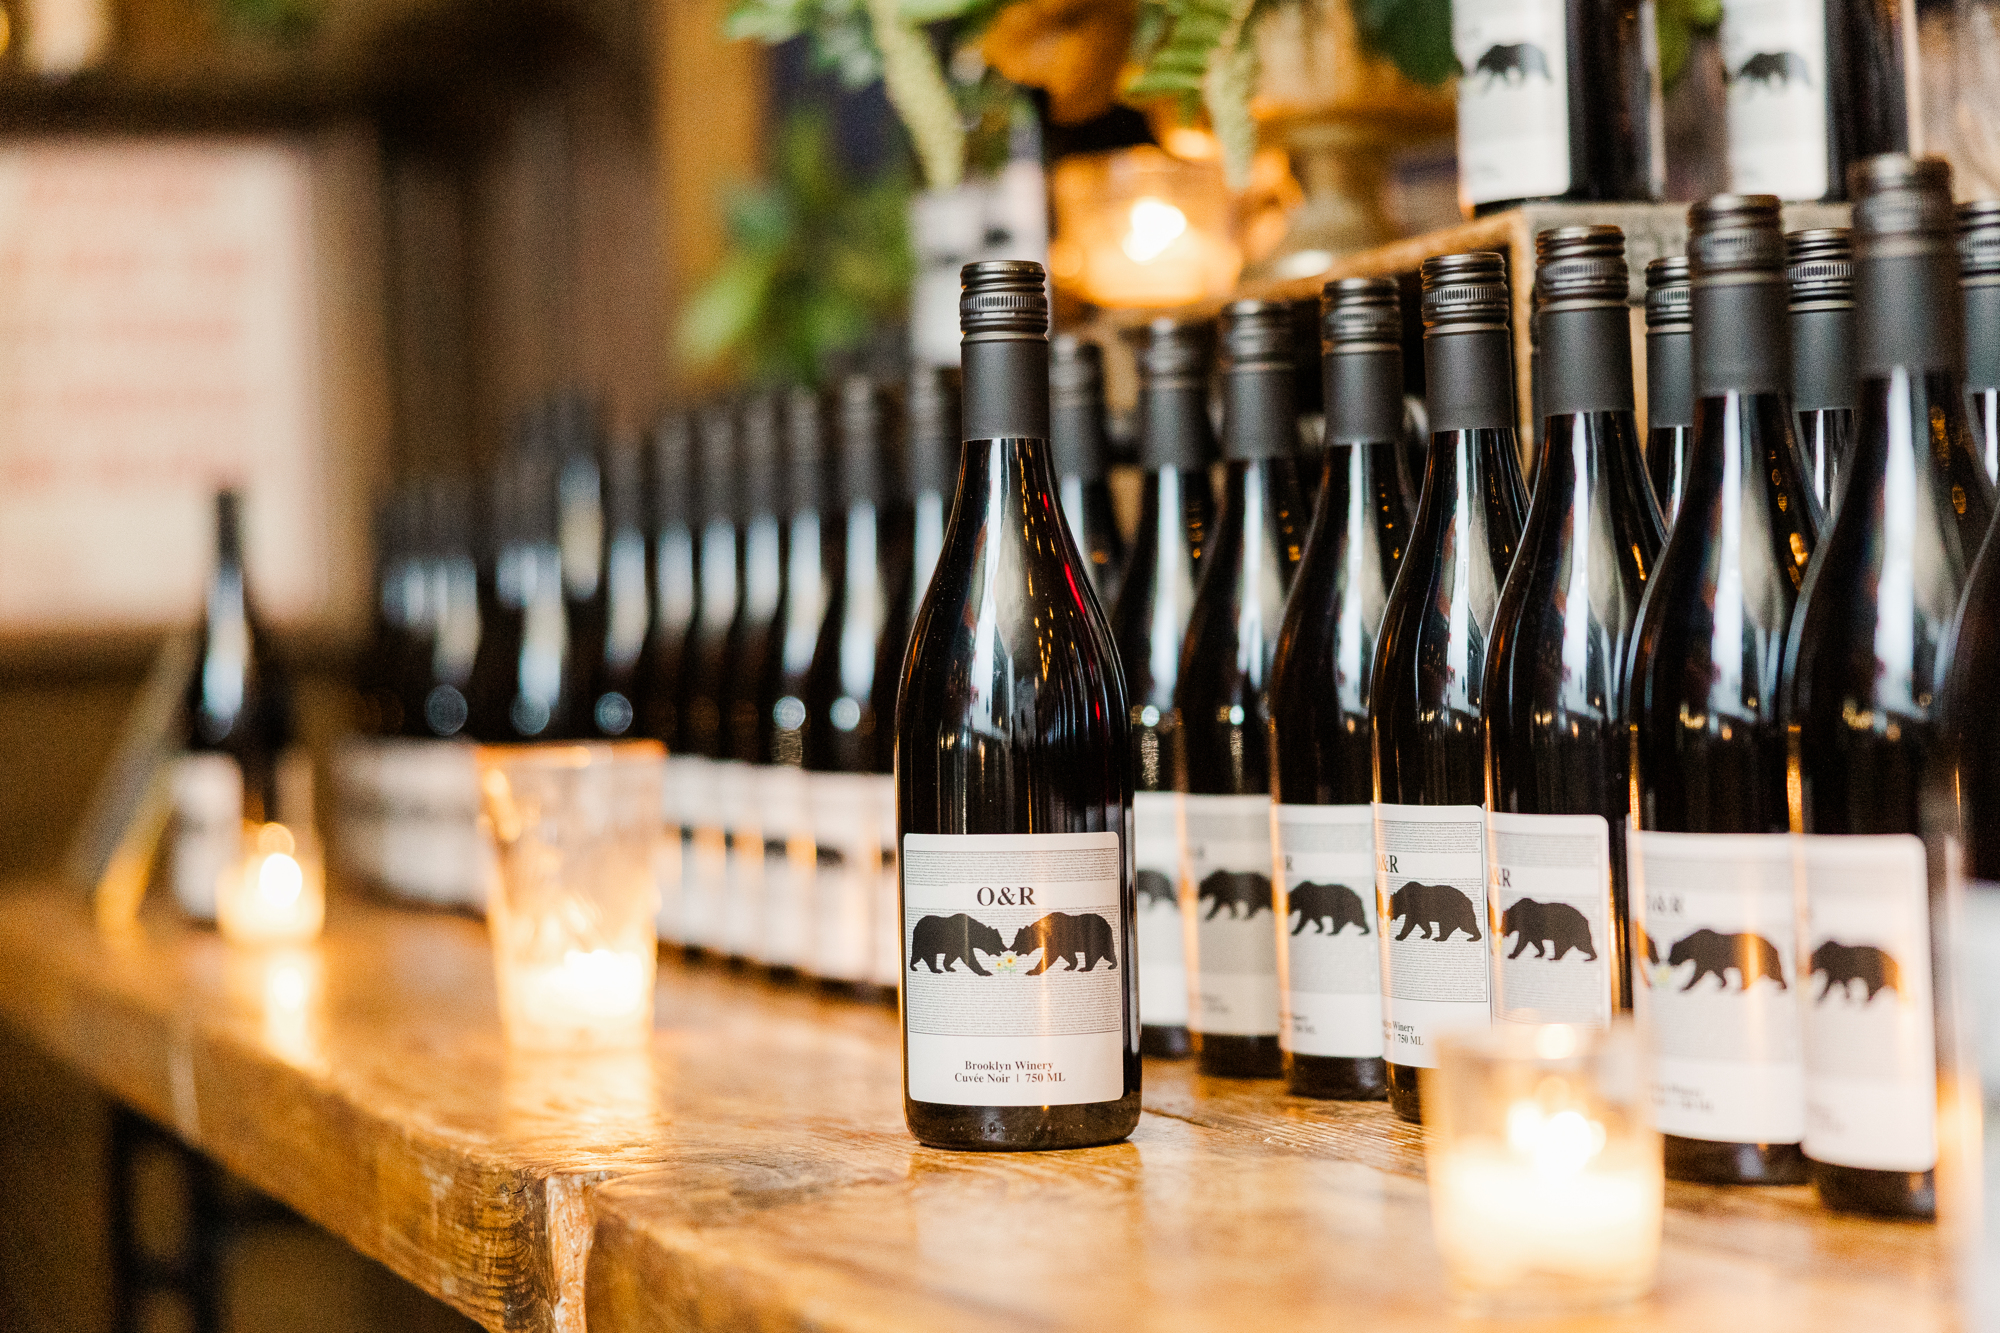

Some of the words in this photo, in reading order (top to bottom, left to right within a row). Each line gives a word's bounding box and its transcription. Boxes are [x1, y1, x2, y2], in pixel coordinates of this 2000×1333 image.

[976, 886, 1036, 907] O&R
[1392, 1020, 1414, 1034] Winery
[1397, 1033, 1409, 1044] 750
[1410, 1036, 1424, 1046] ML
[965, 1060, 1011, 1072] Brooklyn
[1015, 1060, 1054, 1072] Winery
[954, 1072, 984, 1083] Cuvée
[987, 1073, 1010, 1083] Noir
[1025, 1073, 1044, 1083] 750
[1046, 1072, 1066, 1082] ML
